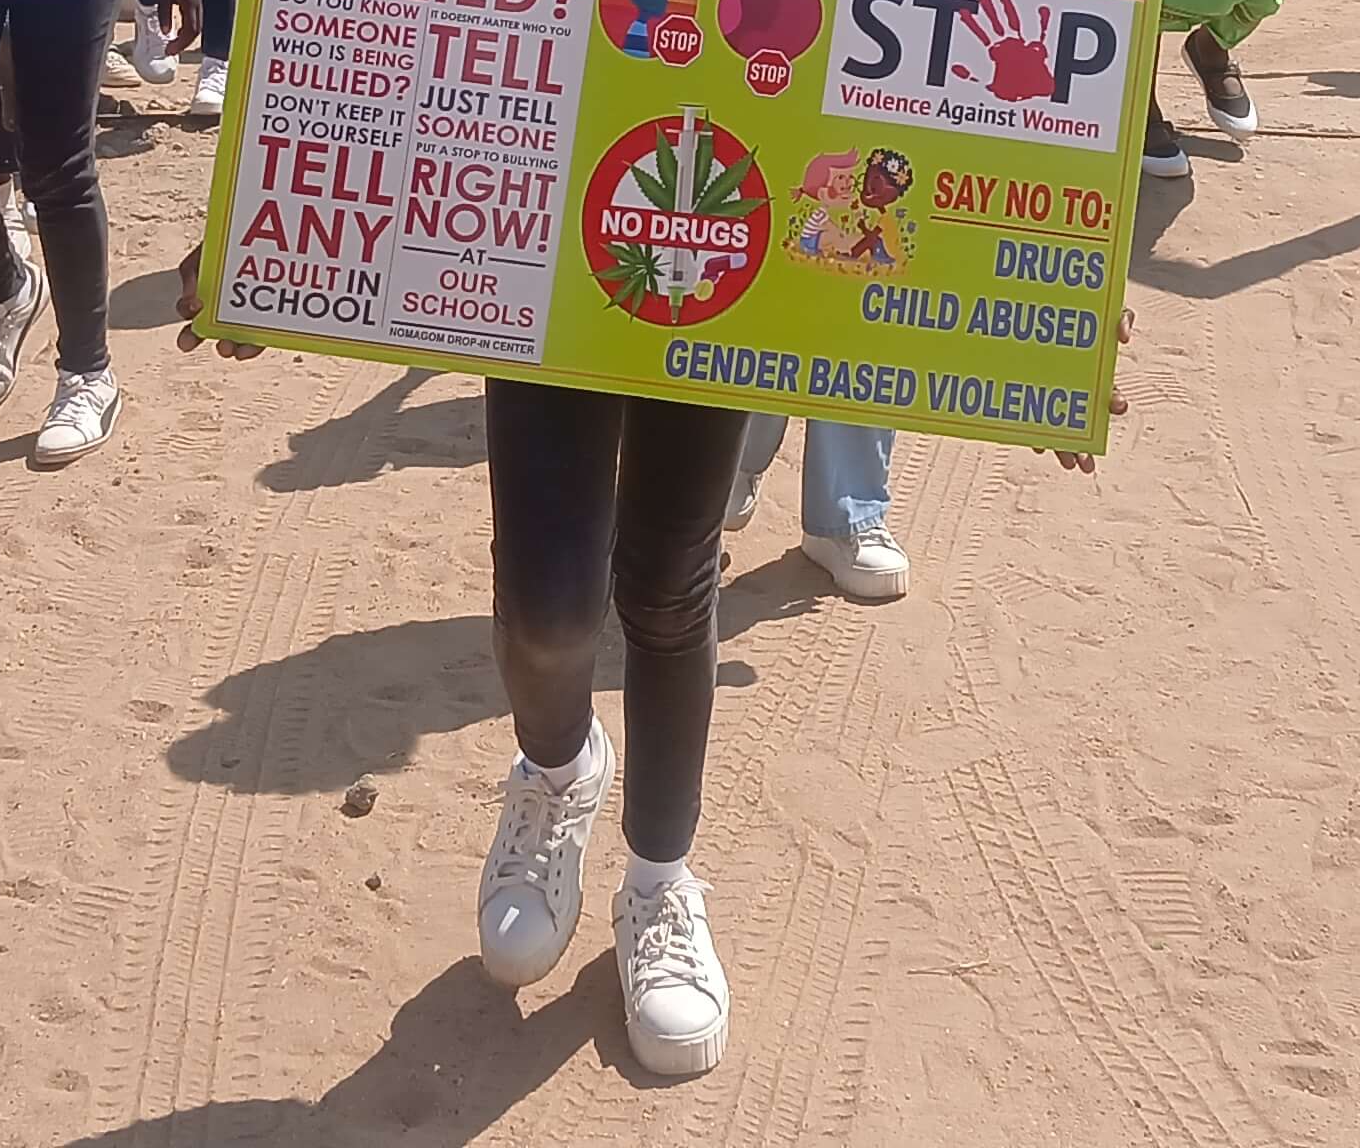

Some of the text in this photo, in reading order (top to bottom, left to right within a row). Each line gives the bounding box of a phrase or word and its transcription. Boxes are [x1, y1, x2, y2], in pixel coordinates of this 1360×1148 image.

[274, 9, 417, 49] SOMEONE
[431, 10, 438, 19] IT
[482, 17, 520, 30] MATTER
[522, 23, 547, 33] WHO
[550, 26, 572, 37] YOU
[659, 30, 698, 52] STOP
[272, 37, 415, 71] WHO IS BEING
[429, 24, 563, 95] TELL
[750, 62, 787, 84] STOP
[267, 59, 411, 101] BULLIED?
[265, 94, 406, 127] DON'T KEEP IT
[419, 86, 558, 125] JUST TELL
[841, 84, 1099, 138] Violence Against Women
[261, 114, 403, 148] TO YOURSELF
[416, 114, 557, 152] SOMEONE
[258, 135, 394, 207] TELL
[416, 142, 559, 170] PUT A STOP TO BULLYING
[410, 157, 557, 210] RIGHT
[934, 171, 1113, 230] SAY NO TO:
[240, 200, 393, 263] ANY
[404, 197, 551, 253] NOW!
[601, 210, 749, 248] NO DRUGS
[237, 255, 381, 297] ADULT IN
[459, 248, 487, 266] AT
[995, 239, 1105, 290] DRUGS
[439, 269, 498, 296] OUR
[229, 282, 376, 326] SCHOOL
[402, 292, 534, 328] SCHOOLS
[862, 283, 1098, 348] CHILD ABUSED
[389, 327, 535, 355] NOMAGOM DROP-IN CENTER
[665, 339, 1089, 430] GENDER BASED VIOLENCE
